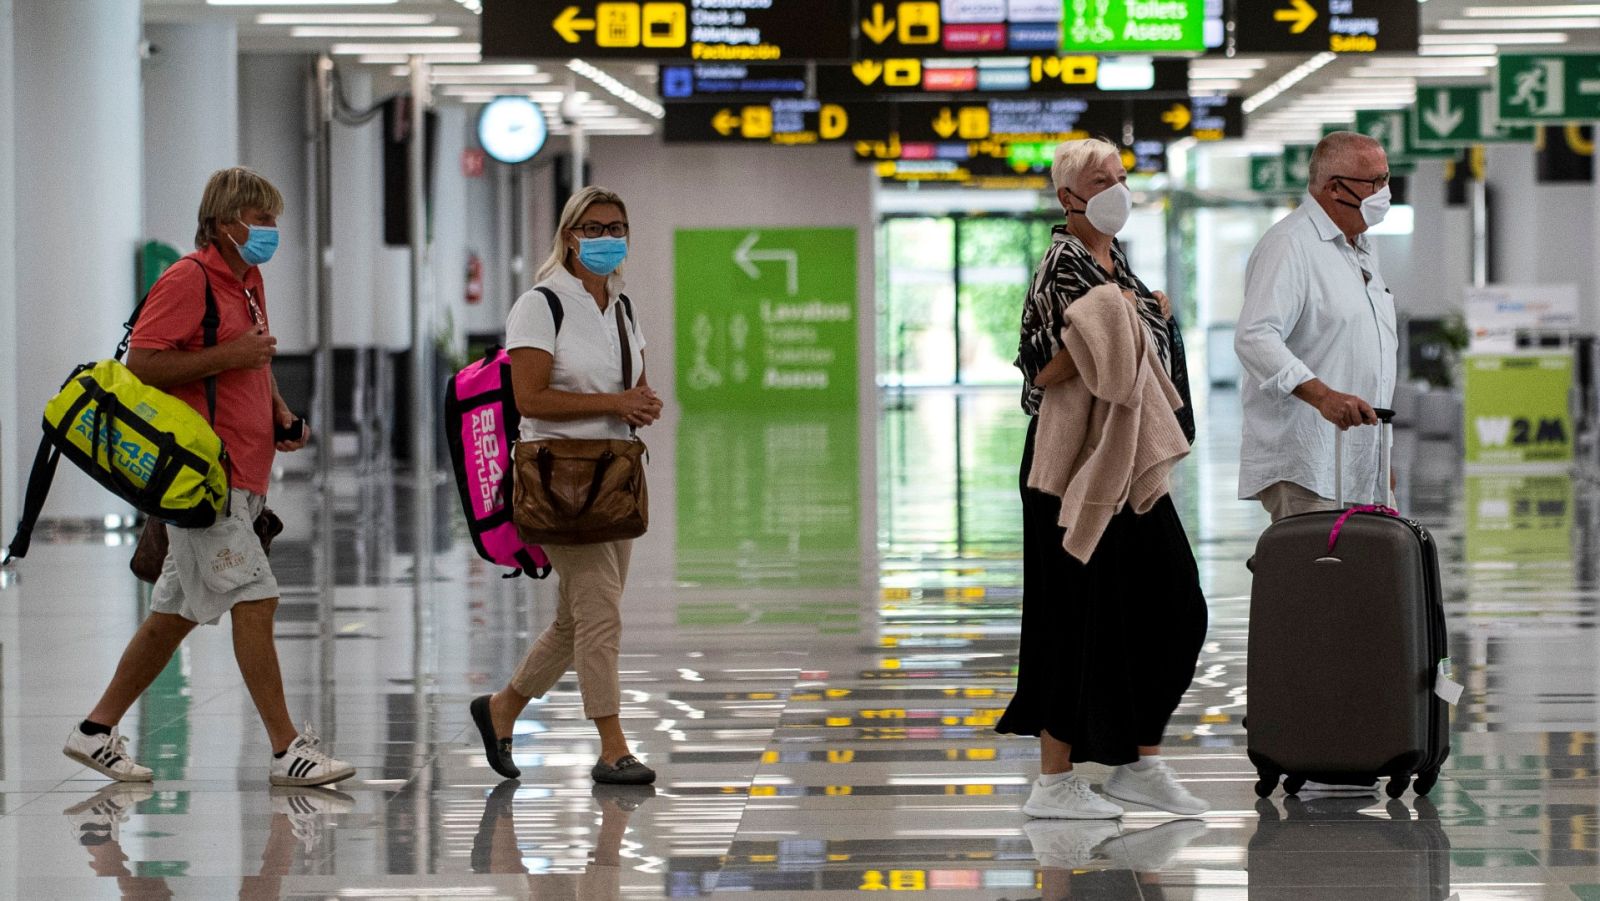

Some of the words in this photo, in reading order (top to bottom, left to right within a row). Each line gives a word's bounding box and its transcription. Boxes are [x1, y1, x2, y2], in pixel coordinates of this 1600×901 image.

[1124, 0, 1188, 19] Toilets
[1124, 19, 1183, 41] Aseos
[692, 42, 780, 60] Facturación
[1330, 34, 1377, 52] Salida
[819, 104, 848, 139] D
[760, 301, 850, 321] Lavabos
[763, 368, 828, 389] Aseos
[1476, 417, 1567, 447] W2M
[472, 413, 493, 513] ALTITUDE
